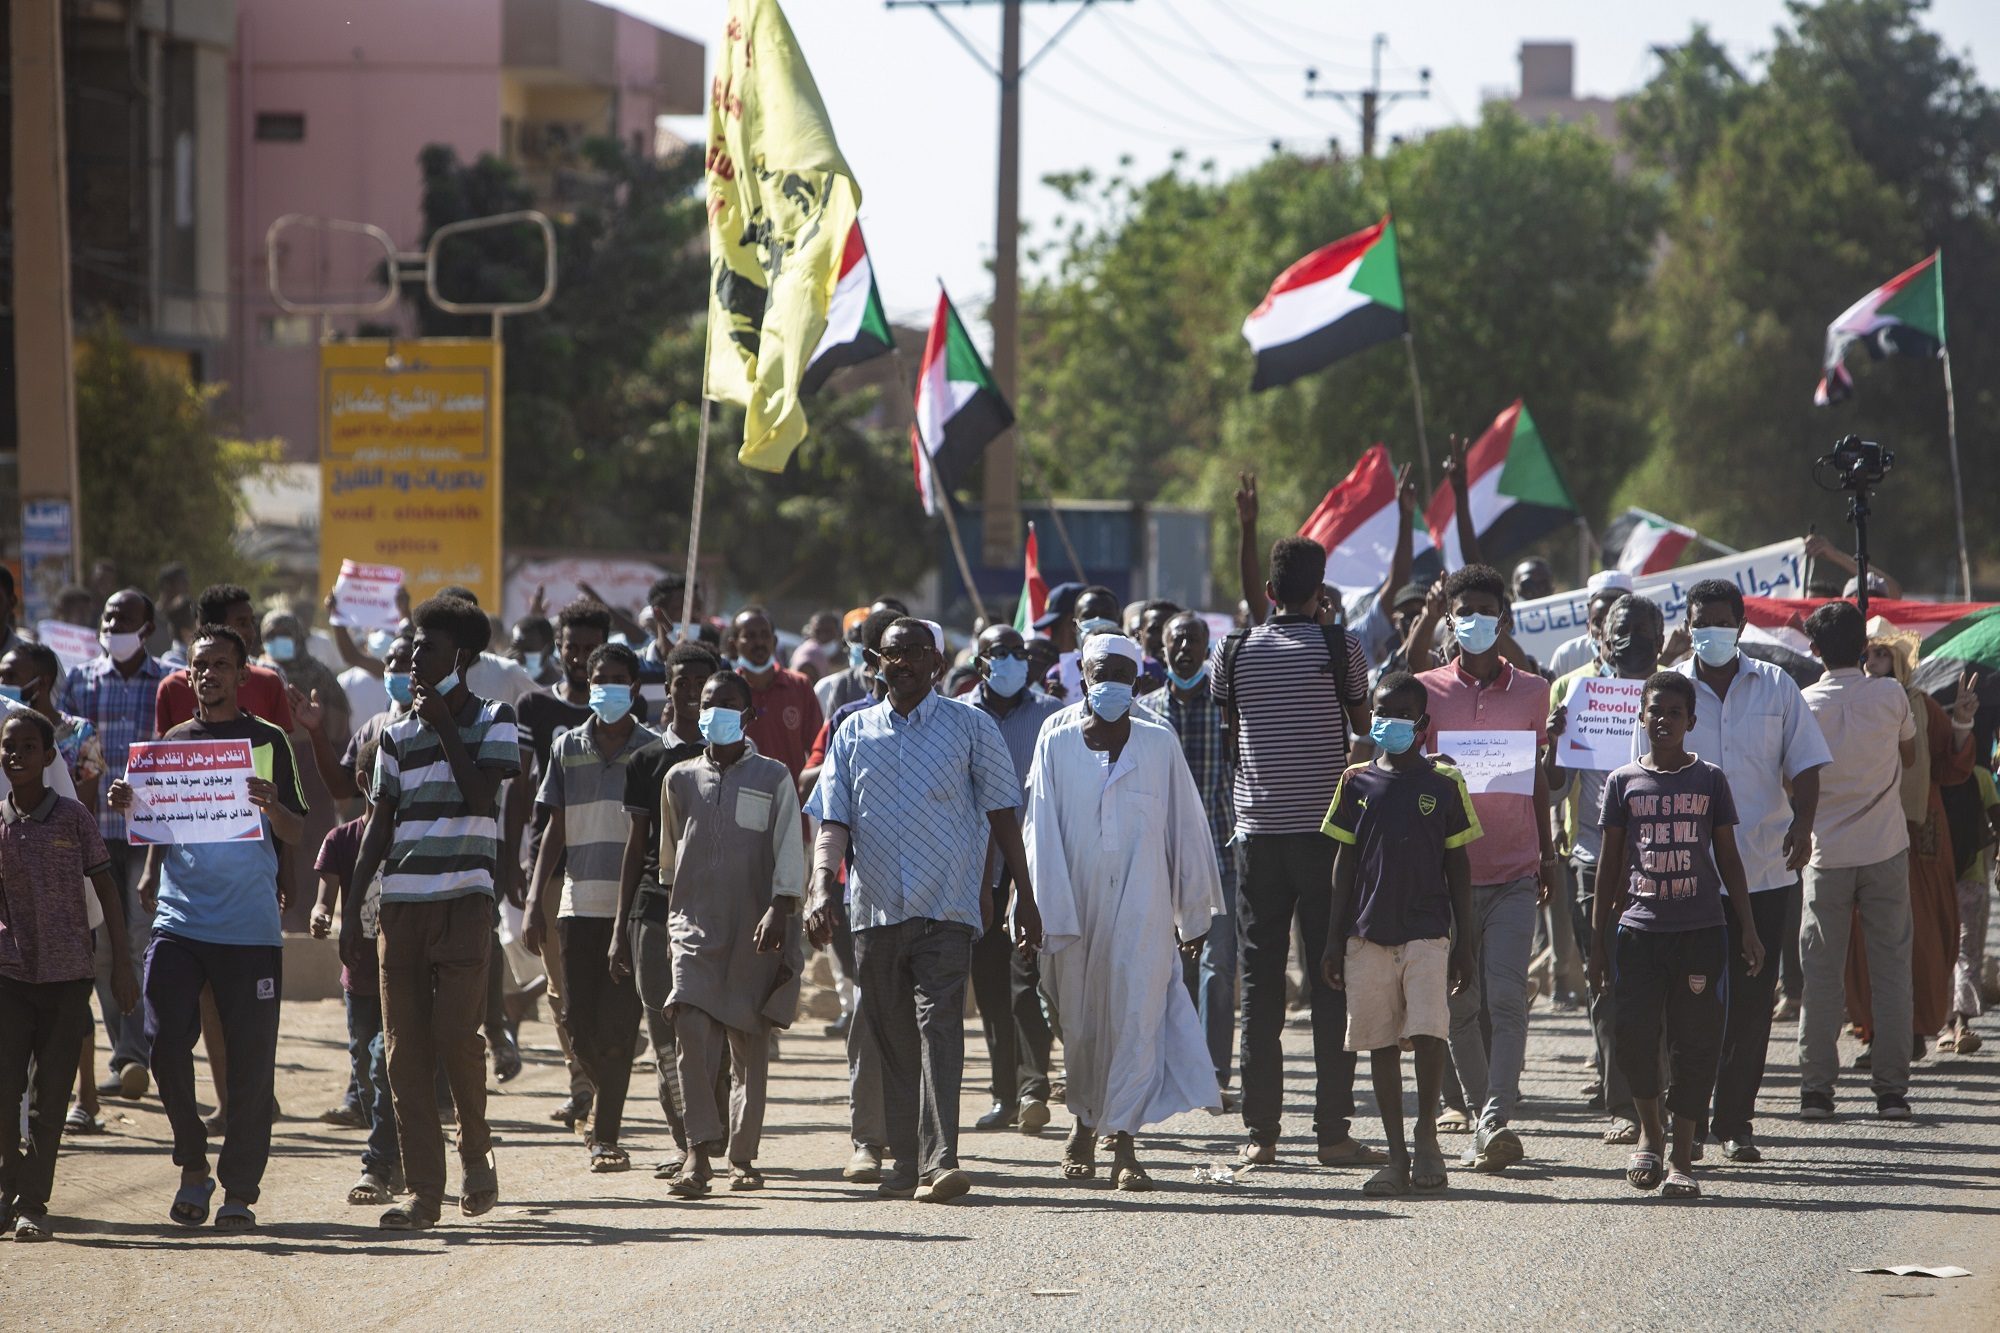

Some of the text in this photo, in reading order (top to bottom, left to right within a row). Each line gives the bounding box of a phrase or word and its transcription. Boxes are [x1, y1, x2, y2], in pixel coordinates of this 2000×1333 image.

[1585, 681, 1641, 696] Non-vio
[1576, 714, 1609, 723] Against
[1612, 716, 1627, 724] The
[186, 751, 213, 767] برهان
[166, 776, 177, 787] بلد
[180, 774, 200, 787] سرقة
[203, 775, 232, 786] يريدون
[149, 792, 178, 806] العملاق
[181, 791, 212, 804] بالشعب
[1674, 793, 1710, 816] MEANT
[210, 809, 227, 821] يكون
[230, 809, 238, 819] لن
[240, 808, 252, 817] هذا
[1640, 821, 1698, 844] TO BE WILL
[1641, 849, 1691, 873] ALWAYS
[1659, 880, 1669, 900] A
[1671, 876, 1698, 900] WAY
